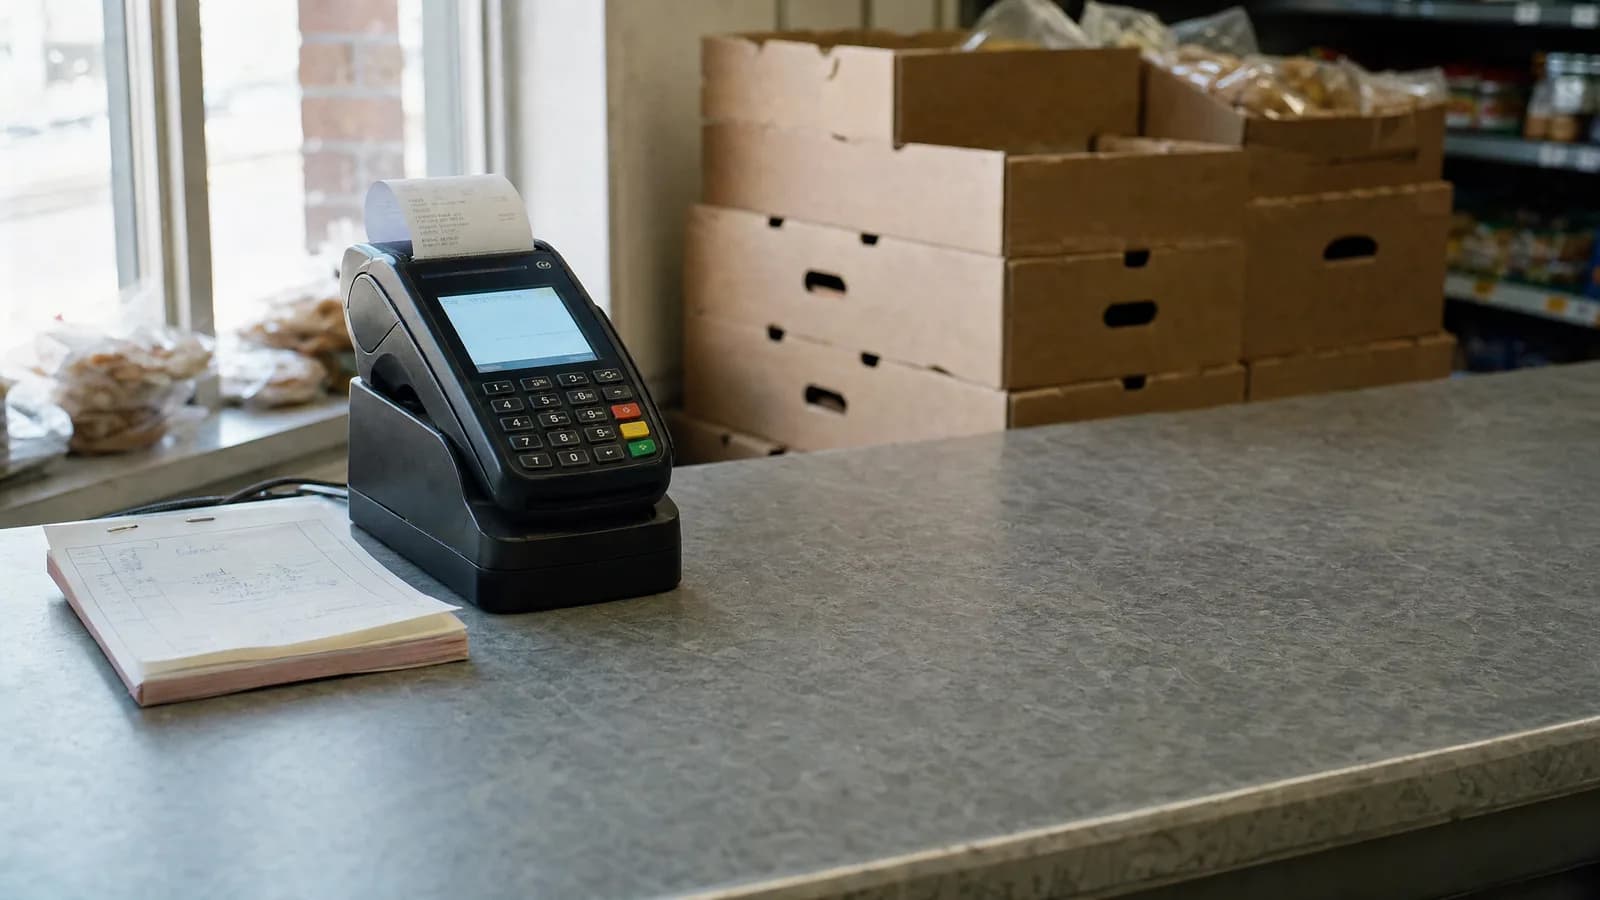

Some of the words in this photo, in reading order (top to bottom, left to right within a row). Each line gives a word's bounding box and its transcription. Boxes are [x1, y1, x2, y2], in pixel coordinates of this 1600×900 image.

[503, 400, 512, 408] 4
[513, 418, 521, 427] 4
[521, 437, 529, 446] 7
[560, 433, 569, 442] 8
[569, 453, 578, 462] 0
